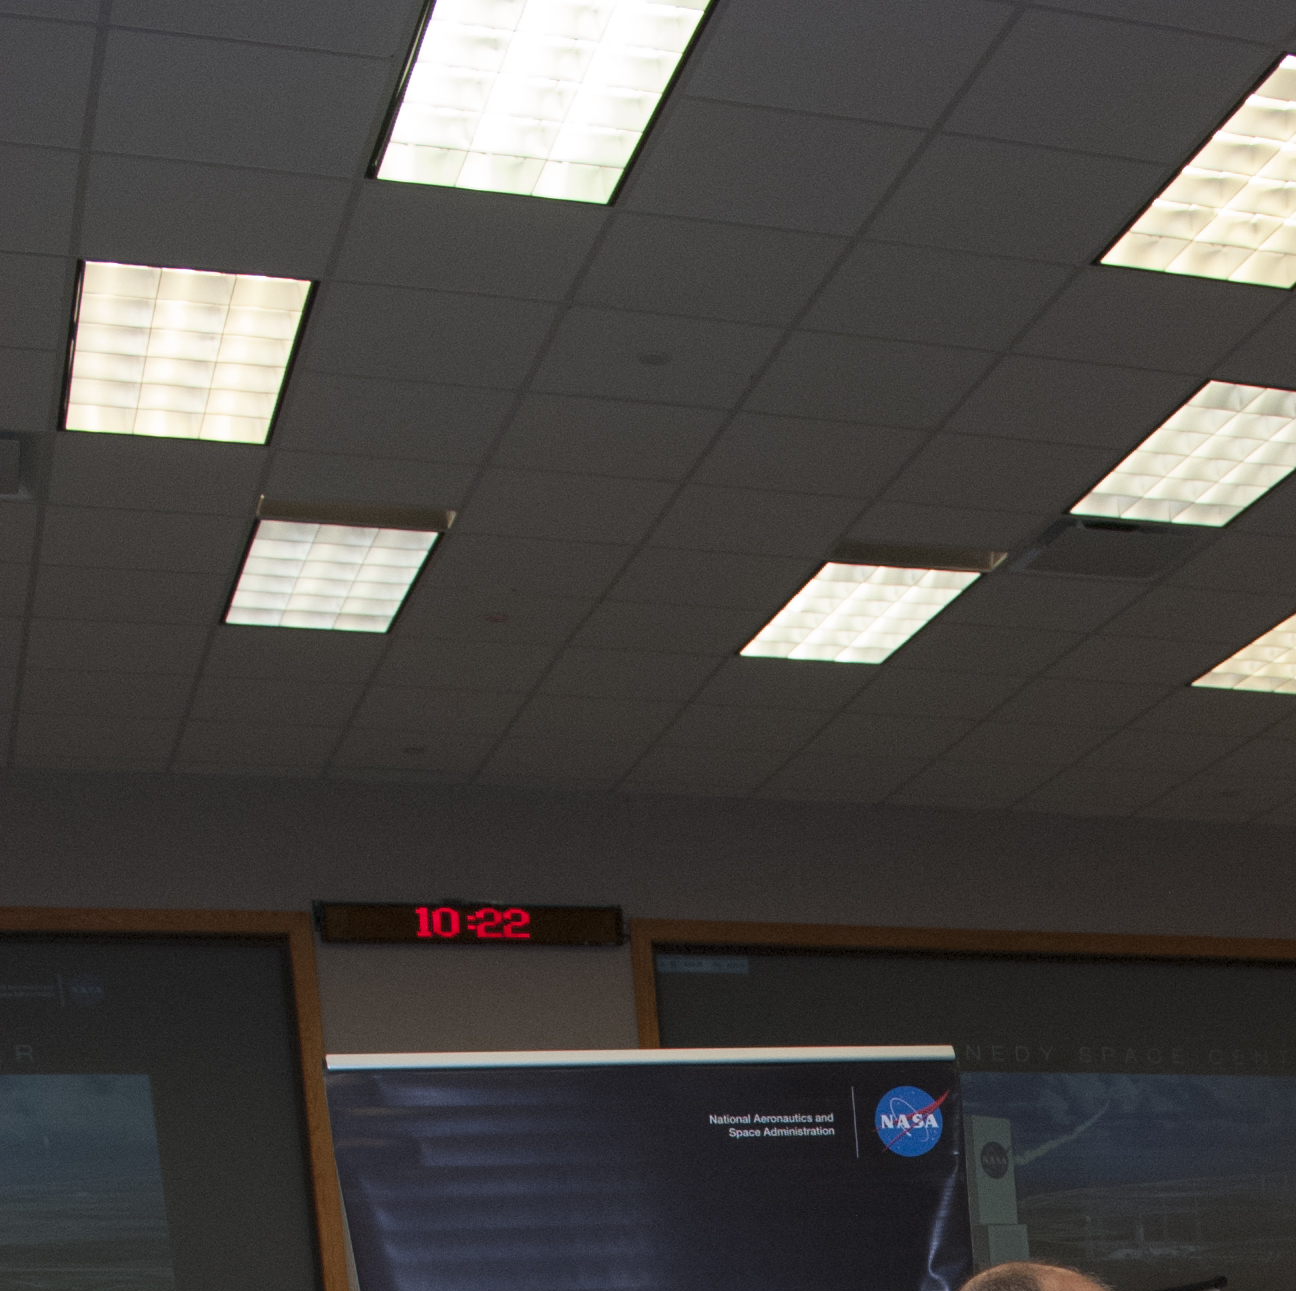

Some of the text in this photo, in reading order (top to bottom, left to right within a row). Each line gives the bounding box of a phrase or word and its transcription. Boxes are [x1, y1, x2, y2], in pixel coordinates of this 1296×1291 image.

[415, 907, 530, 939] 10:22
[965, 1044, 1054, 1062] NEDY
[1078, 1046, 1184, 1064] SPACE
[709, 1112, 833, 1124] National Aeronautics and
[881, 1113, 939, 1129] NASA
[728, 1126, 834, 1139] Space Administration
